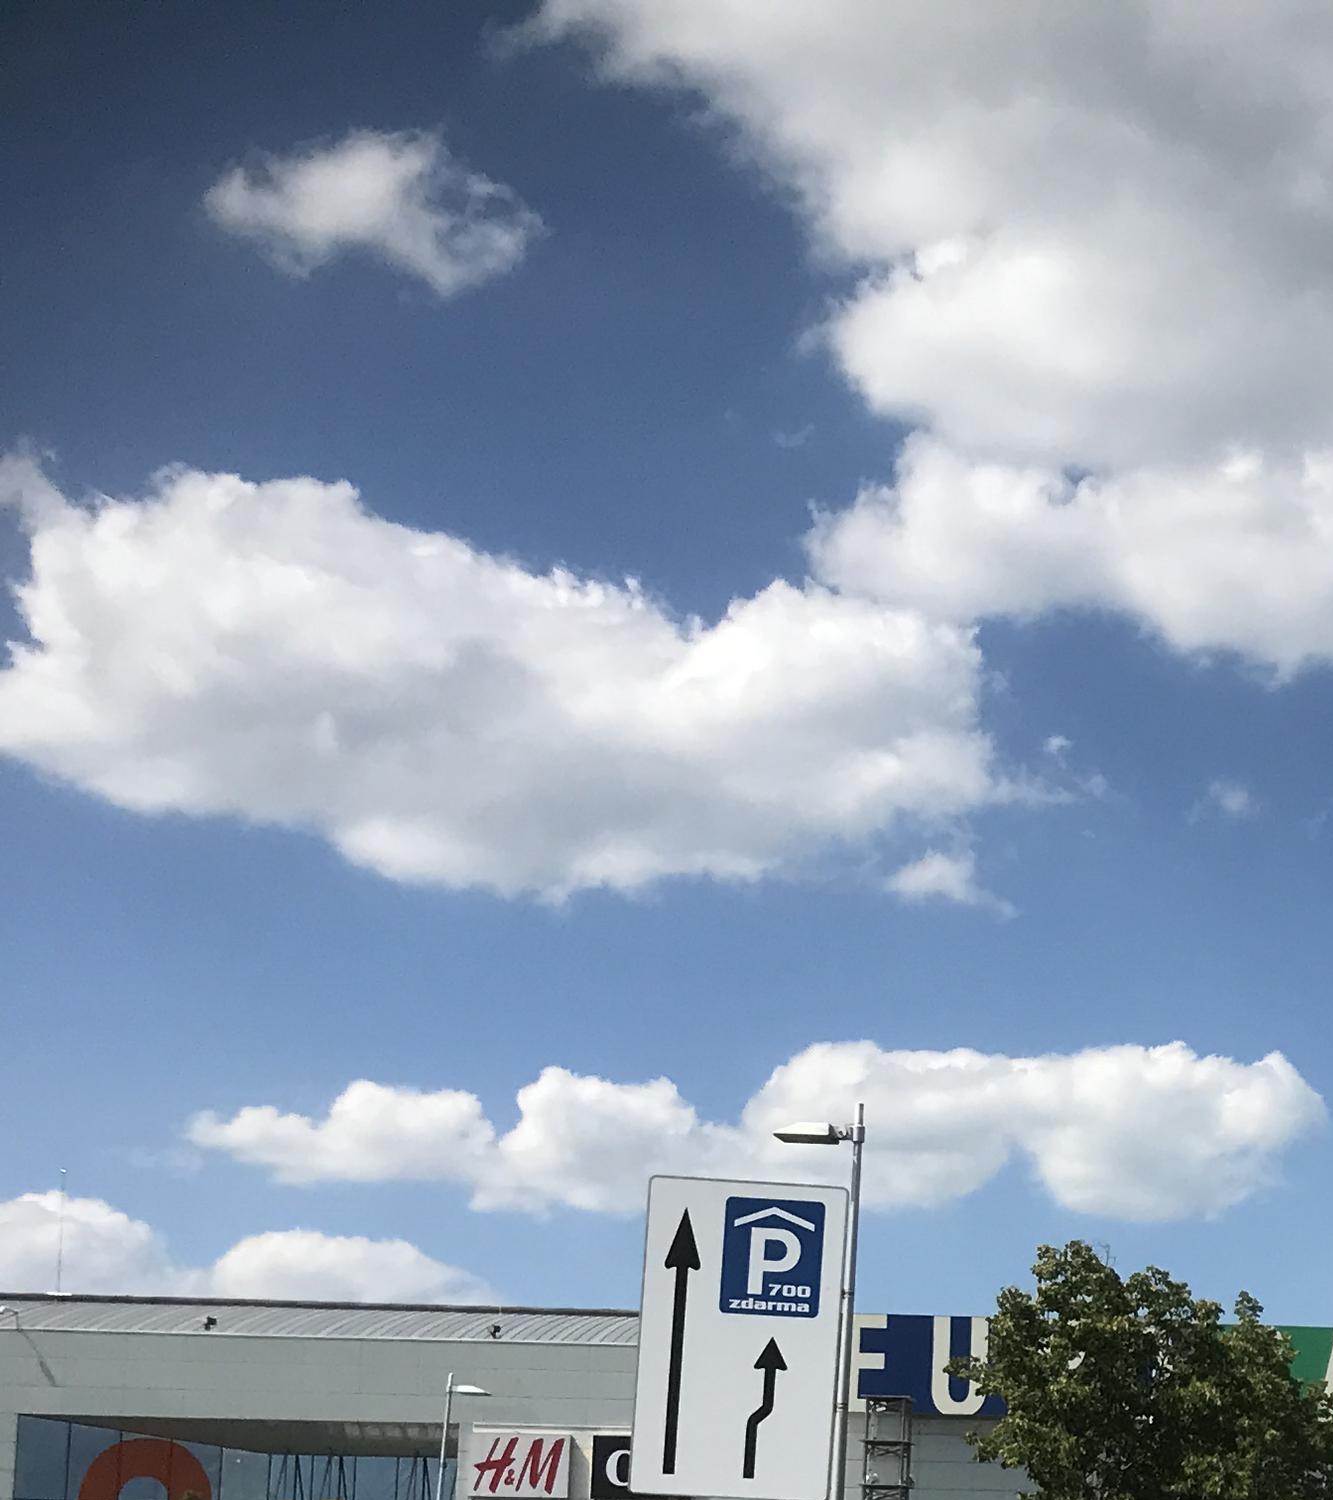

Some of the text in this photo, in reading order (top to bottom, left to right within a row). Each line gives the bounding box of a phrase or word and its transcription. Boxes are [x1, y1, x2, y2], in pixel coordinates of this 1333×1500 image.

[747, 1227, 801, 1295] P
[729, 1297, 810, 1313] zdarma
[768, 1283, 811, 1298] 700
[474, 1437, 565, 1495] H&M
